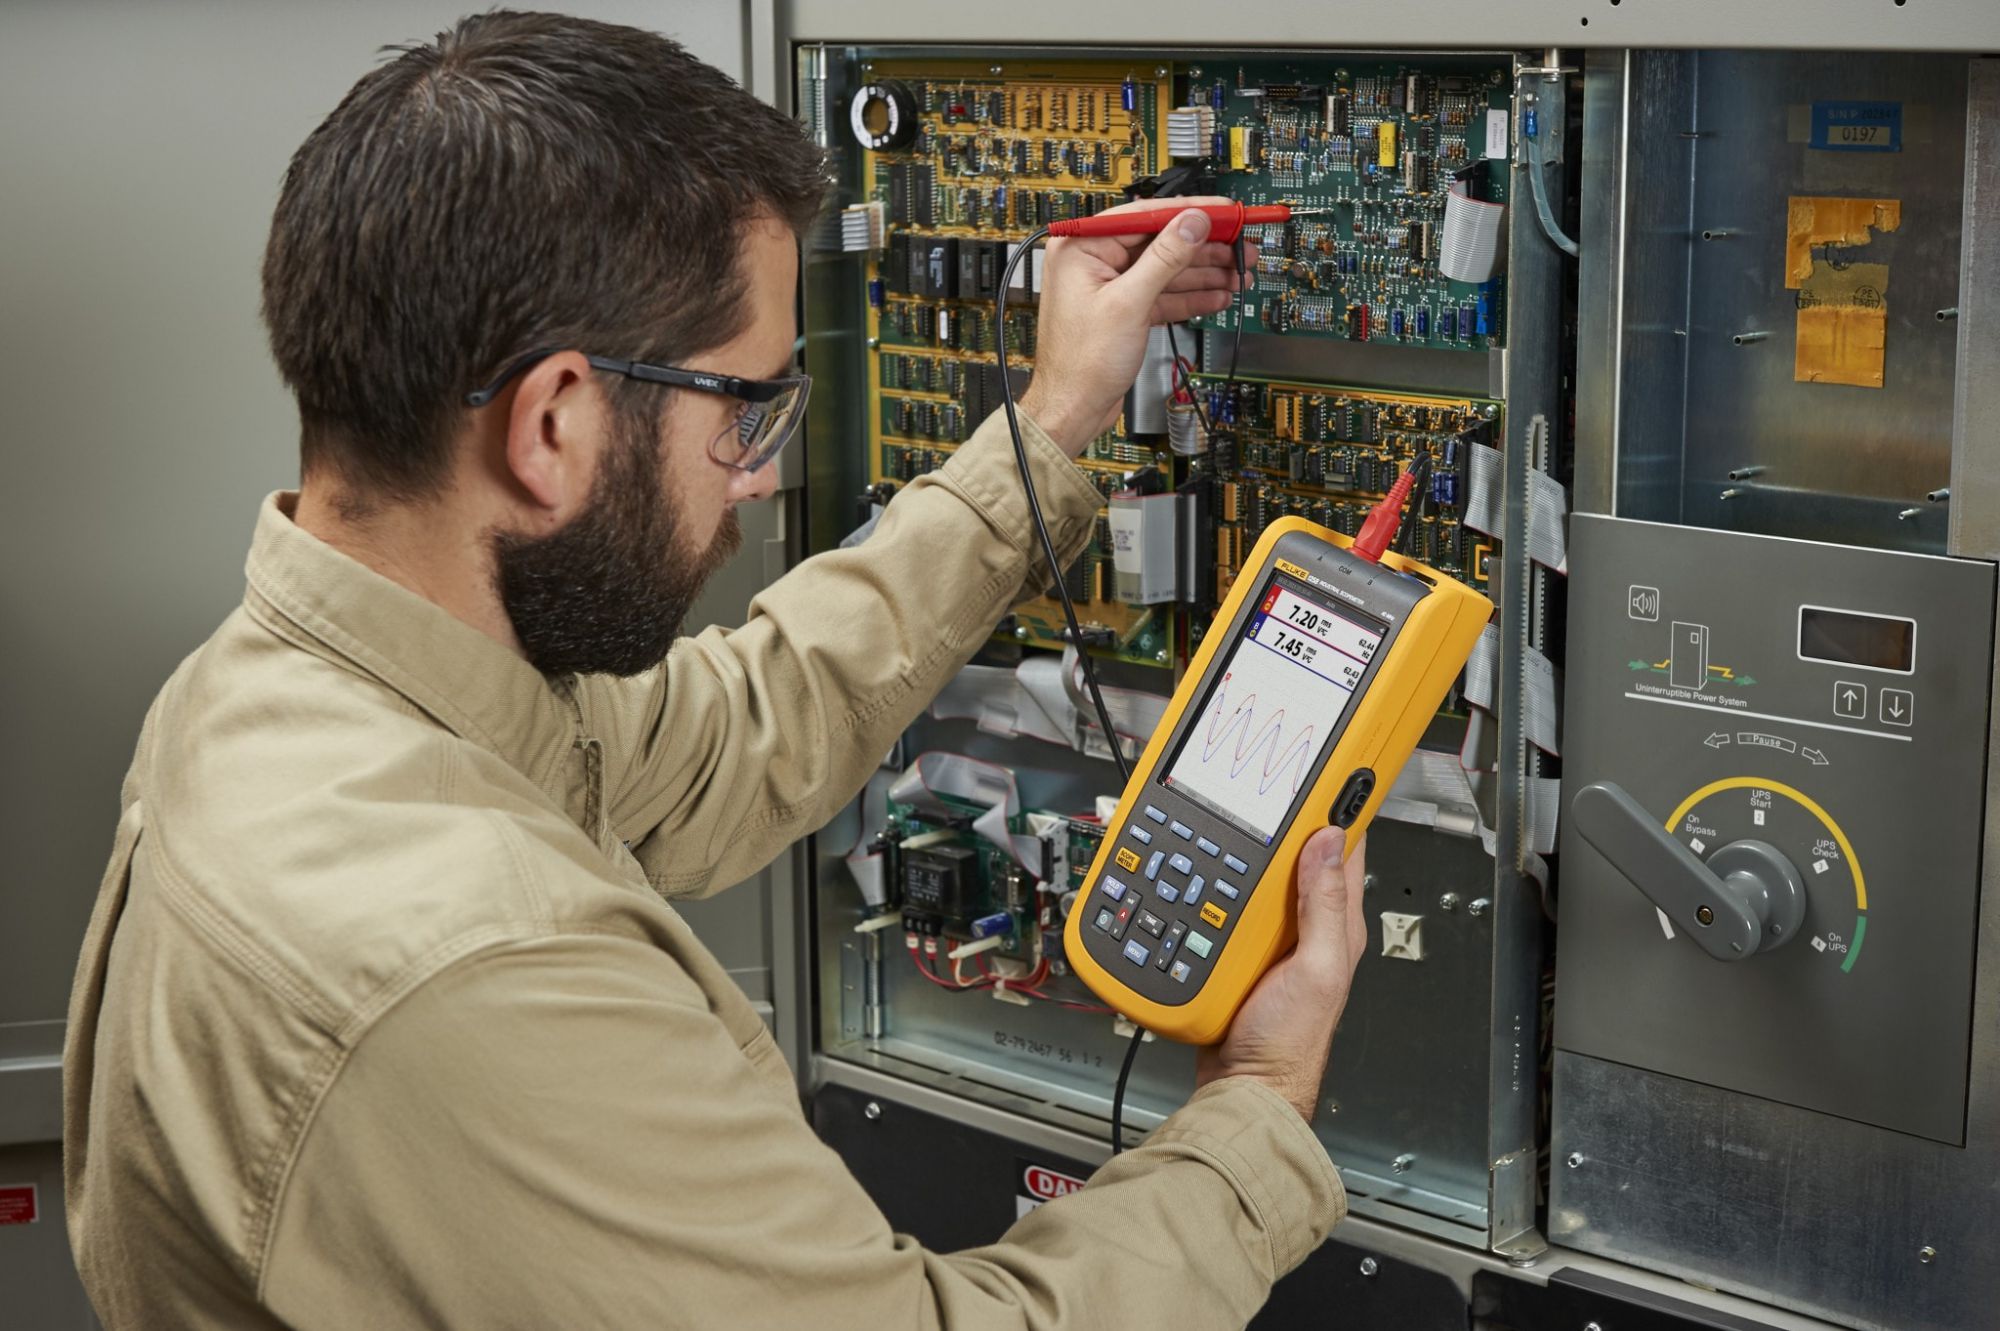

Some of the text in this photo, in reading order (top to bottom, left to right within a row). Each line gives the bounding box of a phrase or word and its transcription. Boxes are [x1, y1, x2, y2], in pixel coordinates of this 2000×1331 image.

[1842, 126, 1878, 142] 0197
[694, 376, 718, 388] UVEX
[1280, 563, 1308, 578] FLUKE
[1338, 565, 1352, 576] COM
[1288, 604, 1332, 630] 7.20 rms
[1253, 622, 1260, 630] B
[1274, 632, 1304, 657] 7.45
[1358, 638, 1375, 652] 62.44
[1362, 650, 1370, 660] Hz
[1343, 666, 1360, 679] 62.43
[1346, 679, 1356, 688] Hz
[1636, 683, 1748, 708] Uninterruptible Power System
[1753, 734, 1781, 748] Pause
[1752, 789, 1772, 800] UPS
[1750, 798, 1772, 808] Start
[1688, 814, 1700, 824] On
[1686, 823, 1717, 837] Bypass
[1816, 840, 1836, 850] UPS
[1120, 850, 1136, 862] SCOPE
[1812, 847, 1840, 859] Check
[1118, 856, 1132, 870] METER
[1107, 879, 1120, 890] HOLD
[1203, 908, 1221, 922] RECORD
[1828, 932, 1842, 942] On
[1828, 942, 1847, 954] UPS
